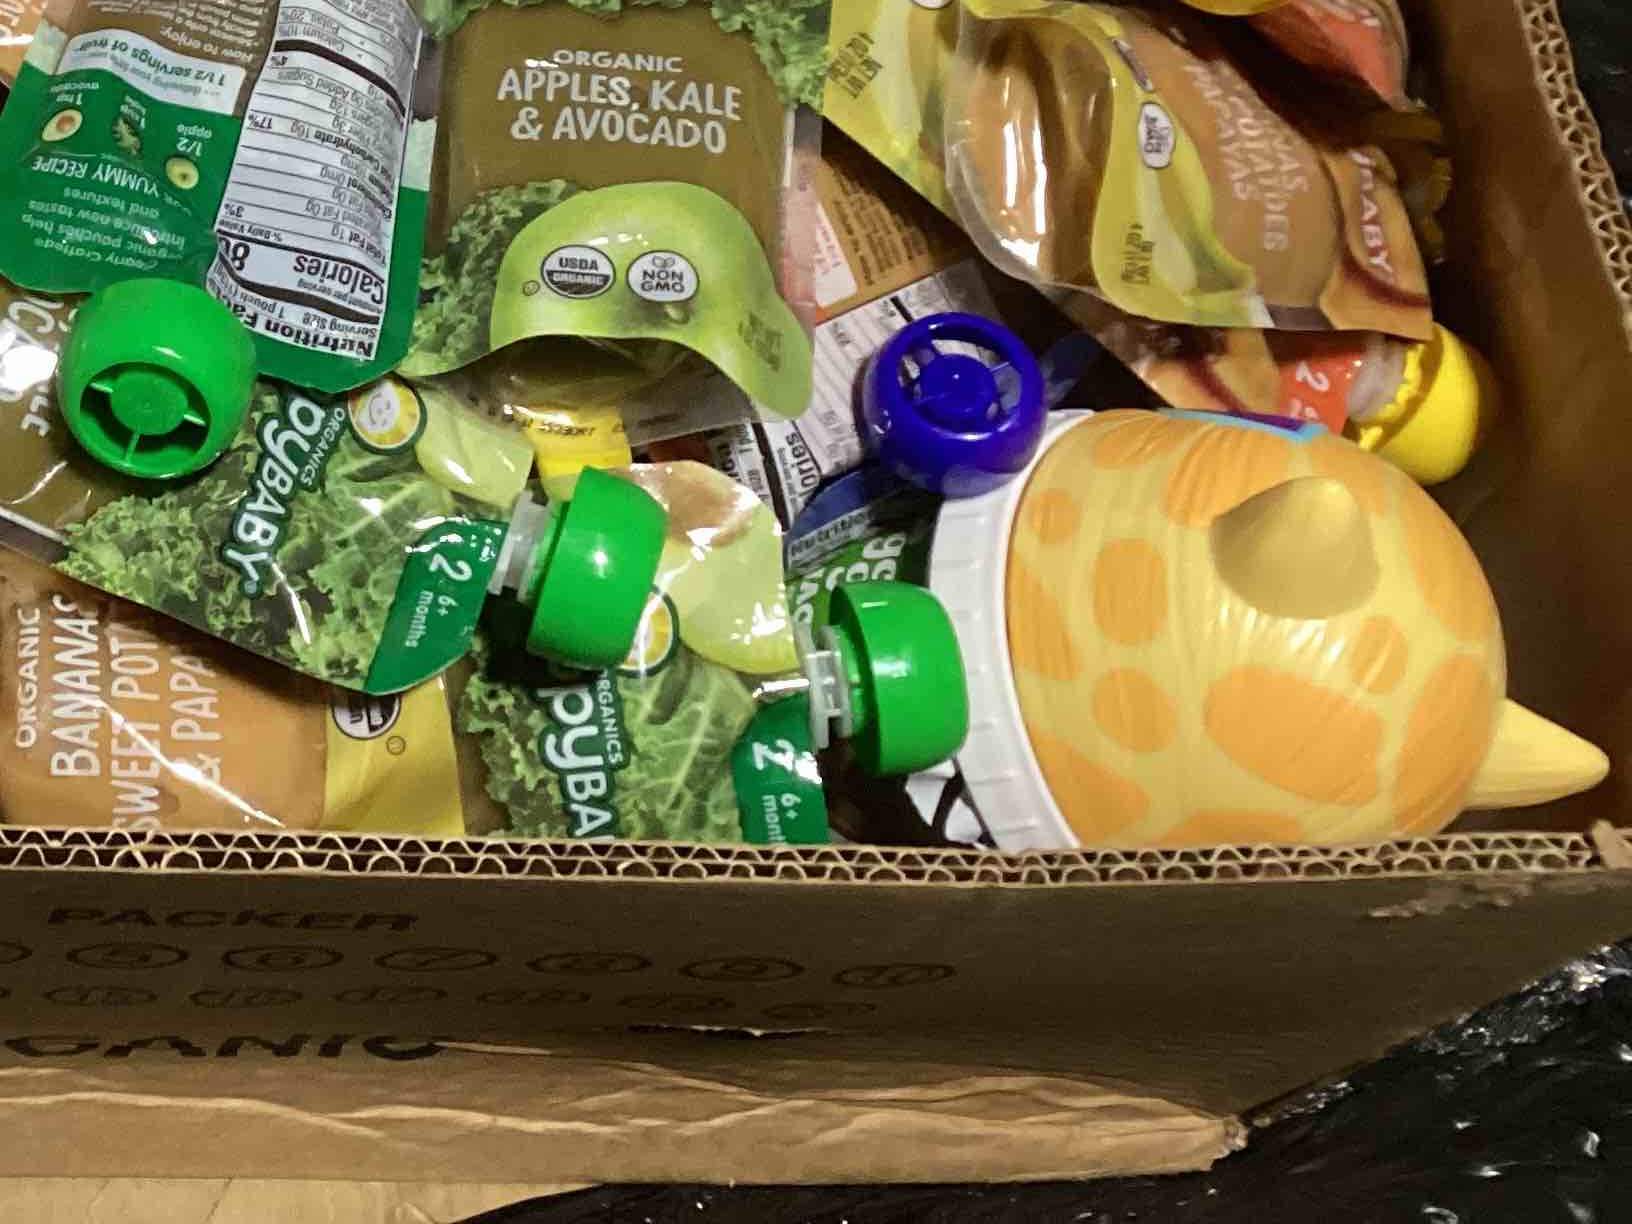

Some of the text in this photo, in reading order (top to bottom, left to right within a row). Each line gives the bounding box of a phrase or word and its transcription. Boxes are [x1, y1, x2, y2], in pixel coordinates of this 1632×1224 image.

[110, 40, 128, 53] of
[129, 46, 193, 78] servings
[552, 49, 685, 74] ORGANIC
[496, 68, 744, 122] APPLES, KALE
[174, 135, 204, 156] 1/2
[175, 121, 212, 140] apple
[510, 106, 728, 154] & AVOCADO
[31, 152, 161, 196] YUMMY RECIPE
[62, 186, 159, 217] and textures
[19, 212, 55, 236] help
[289, 254, 388, 305] Calories
[557, 257, 601, 273] USDA
[639, 268, 685, 283] NON
[638, 279, 686, 295] GMO
[263, 299, 376, 357] Nutrition
[299, 406, 346, 486] ORGANICS
[428, 552, 473, 617] 2 6+
[404, 589, 434, 649] months
[15, 607, 41, 749] ORGANIC
[599, 672, 625, 767] RGANICS
